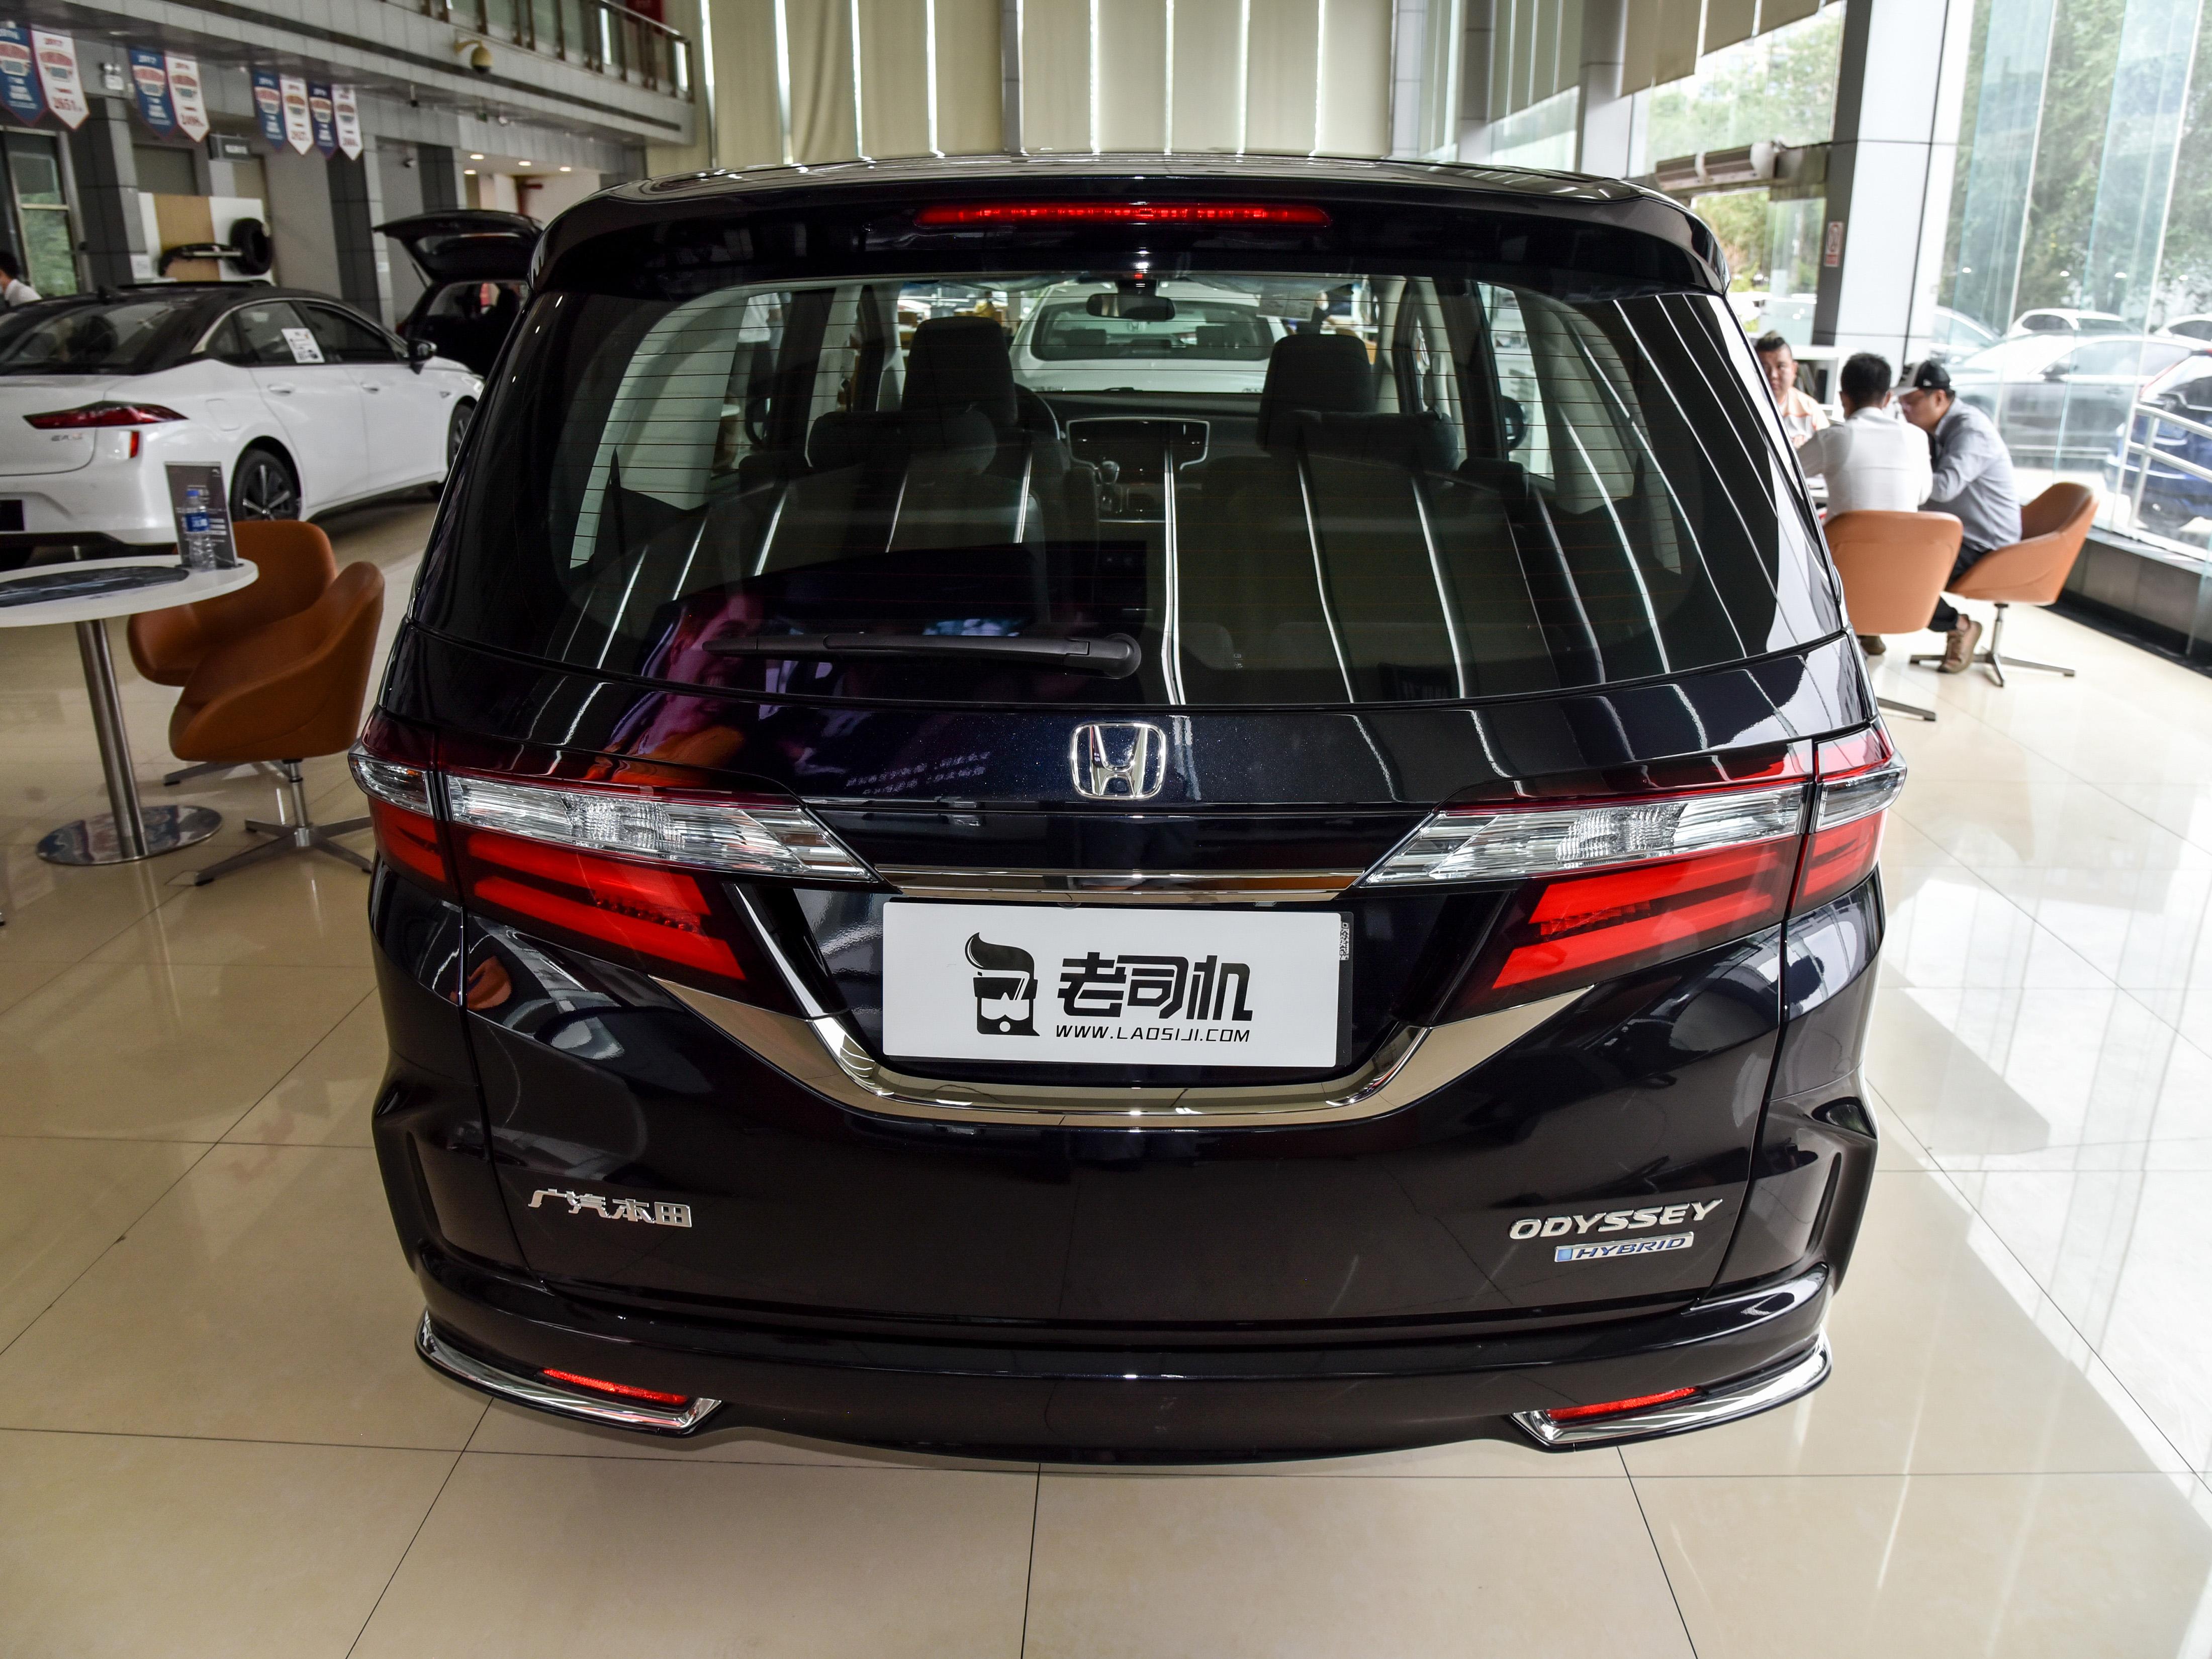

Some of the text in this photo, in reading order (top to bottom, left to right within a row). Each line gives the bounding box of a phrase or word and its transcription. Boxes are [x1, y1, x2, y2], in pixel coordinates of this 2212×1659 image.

[1057, 952, 1253, 1021] 老司机
[1056, 1025, 1250, 1042] WWW.LAOSIJI.COM
[528, 1188, 692, 1227] 广汽本田
[1509, 1199, 1723, 1240] ODYSSEY
[1576, 1238, 1686, 1258] HYBRID
